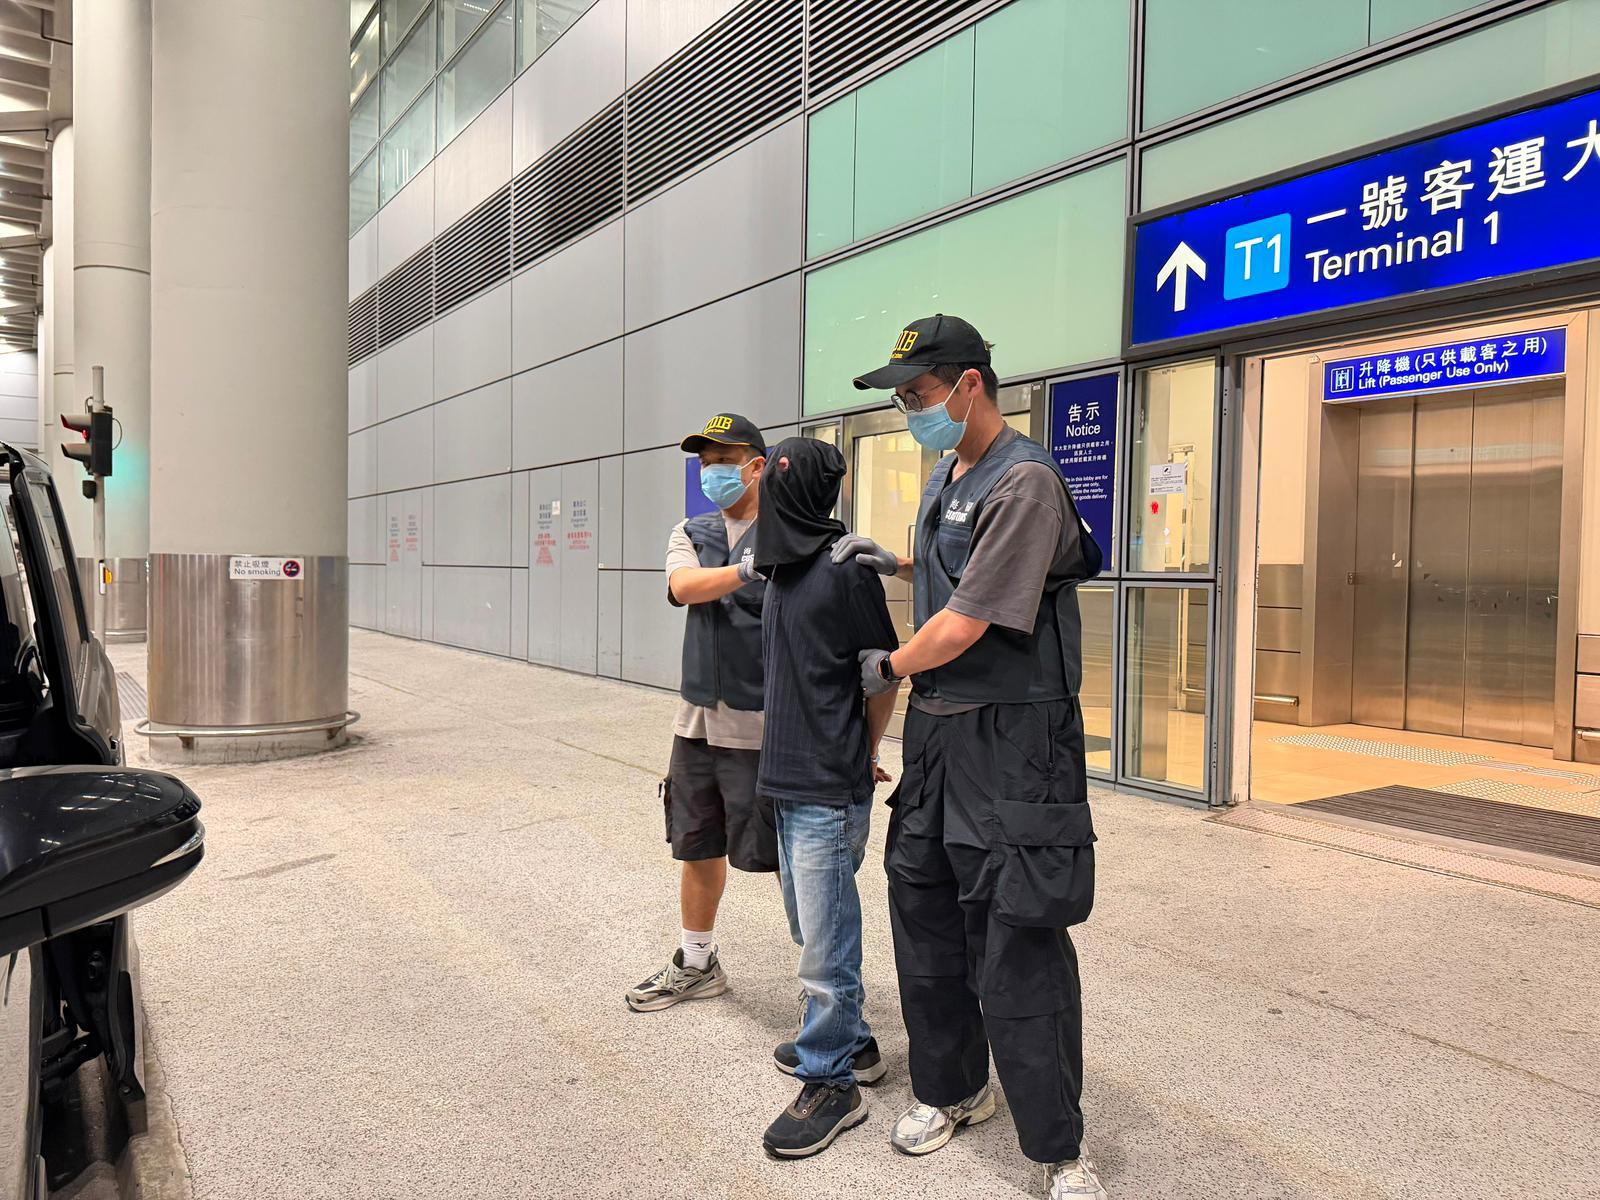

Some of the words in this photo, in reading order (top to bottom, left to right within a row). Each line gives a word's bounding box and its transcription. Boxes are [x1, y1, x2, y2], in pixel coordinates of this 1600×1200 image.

[1306, 119, 1600, 231] 一號客運大
[1234, 233, 1281, 280] T1
[1305, 217, 1463, 282] Terminal
[1483, 211, 1499, 245] 1
[1359, 378, 1376, 390] Lift
[1379, 370, 1443, 388] (Passenger
[1447, 367, 1470, 378] Use
[1474, 360, 1509, 374] Only)
[1068, 401, 1100, 423] 告示
[1066, 423, 1101, 437] Notice
[247, 568, 281, 577] smoking
